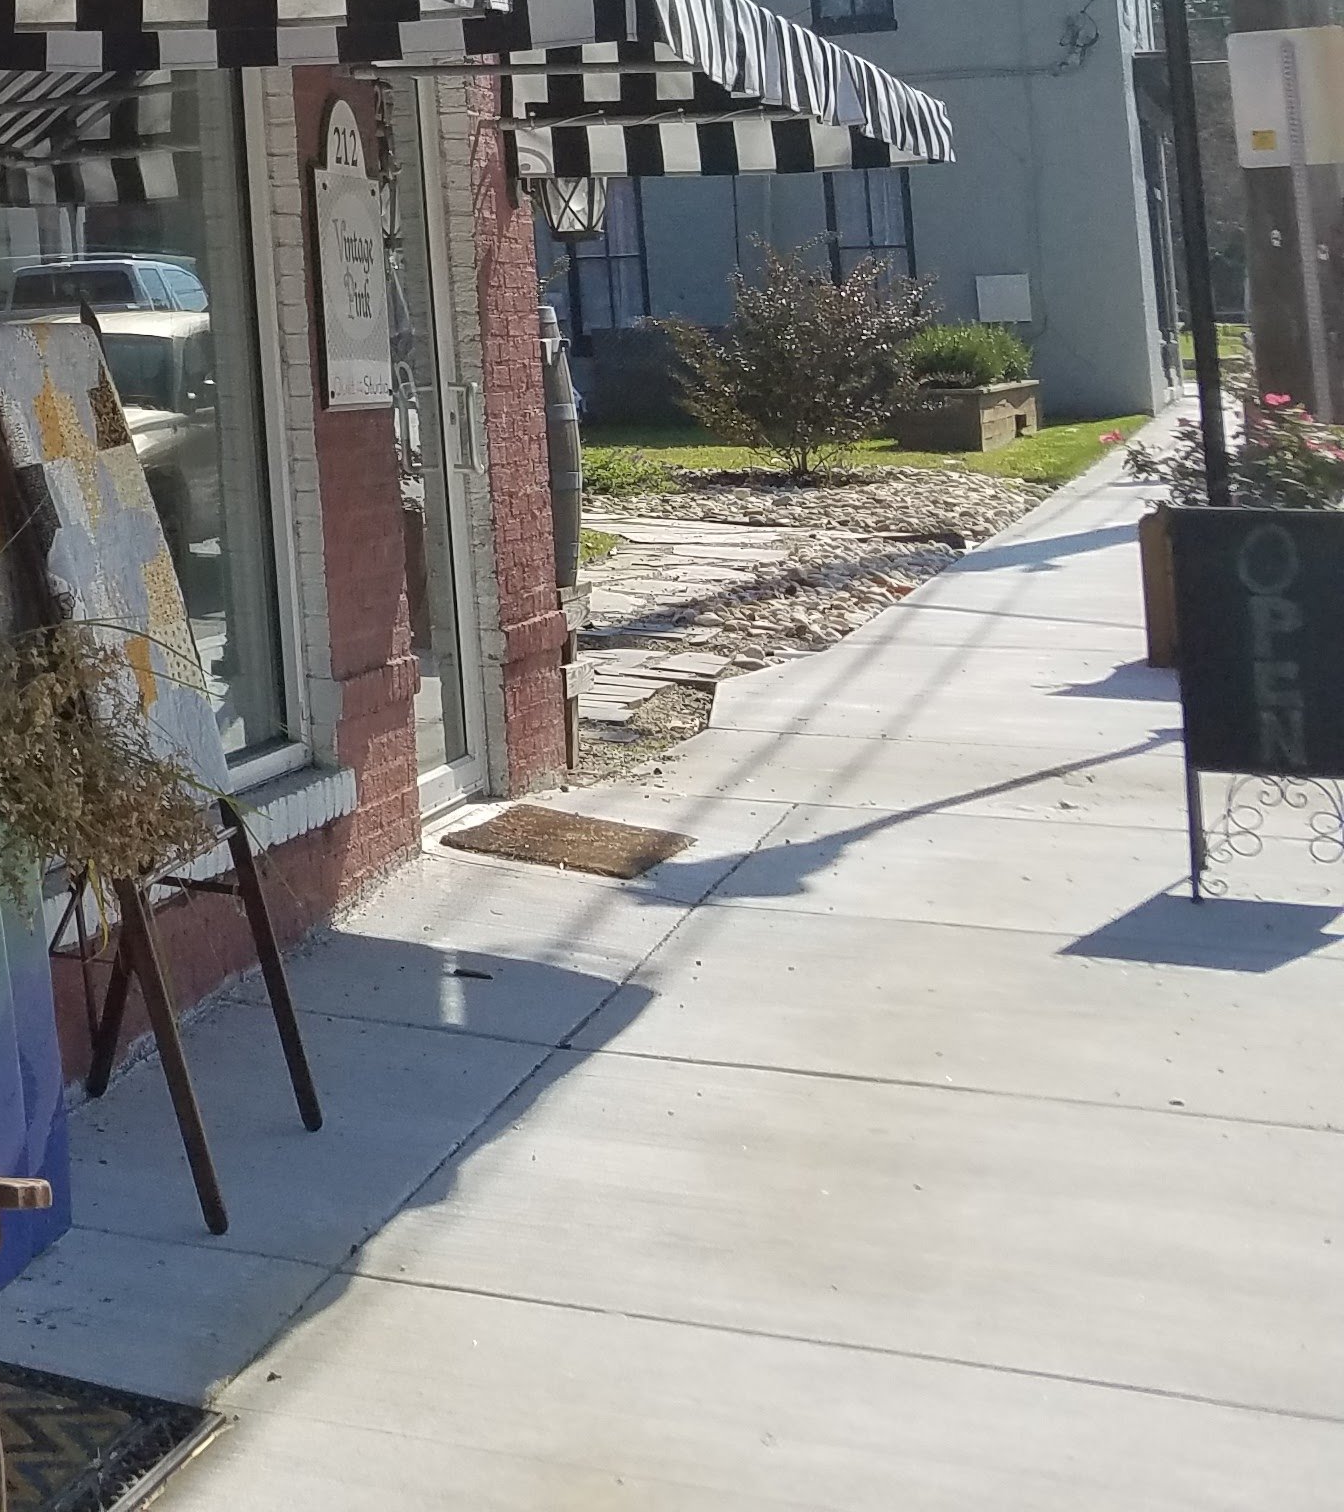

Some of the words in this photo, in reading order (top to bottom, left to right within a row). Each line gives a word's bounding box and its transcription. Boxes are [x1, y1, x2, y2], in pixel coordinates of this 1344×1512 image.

[333, 126, 359, 168] 212
[332, 218, 374, 274] Vintage
[343, 265, 372, 320] Pink
[1237, 522, 1308, 767] OPEN
